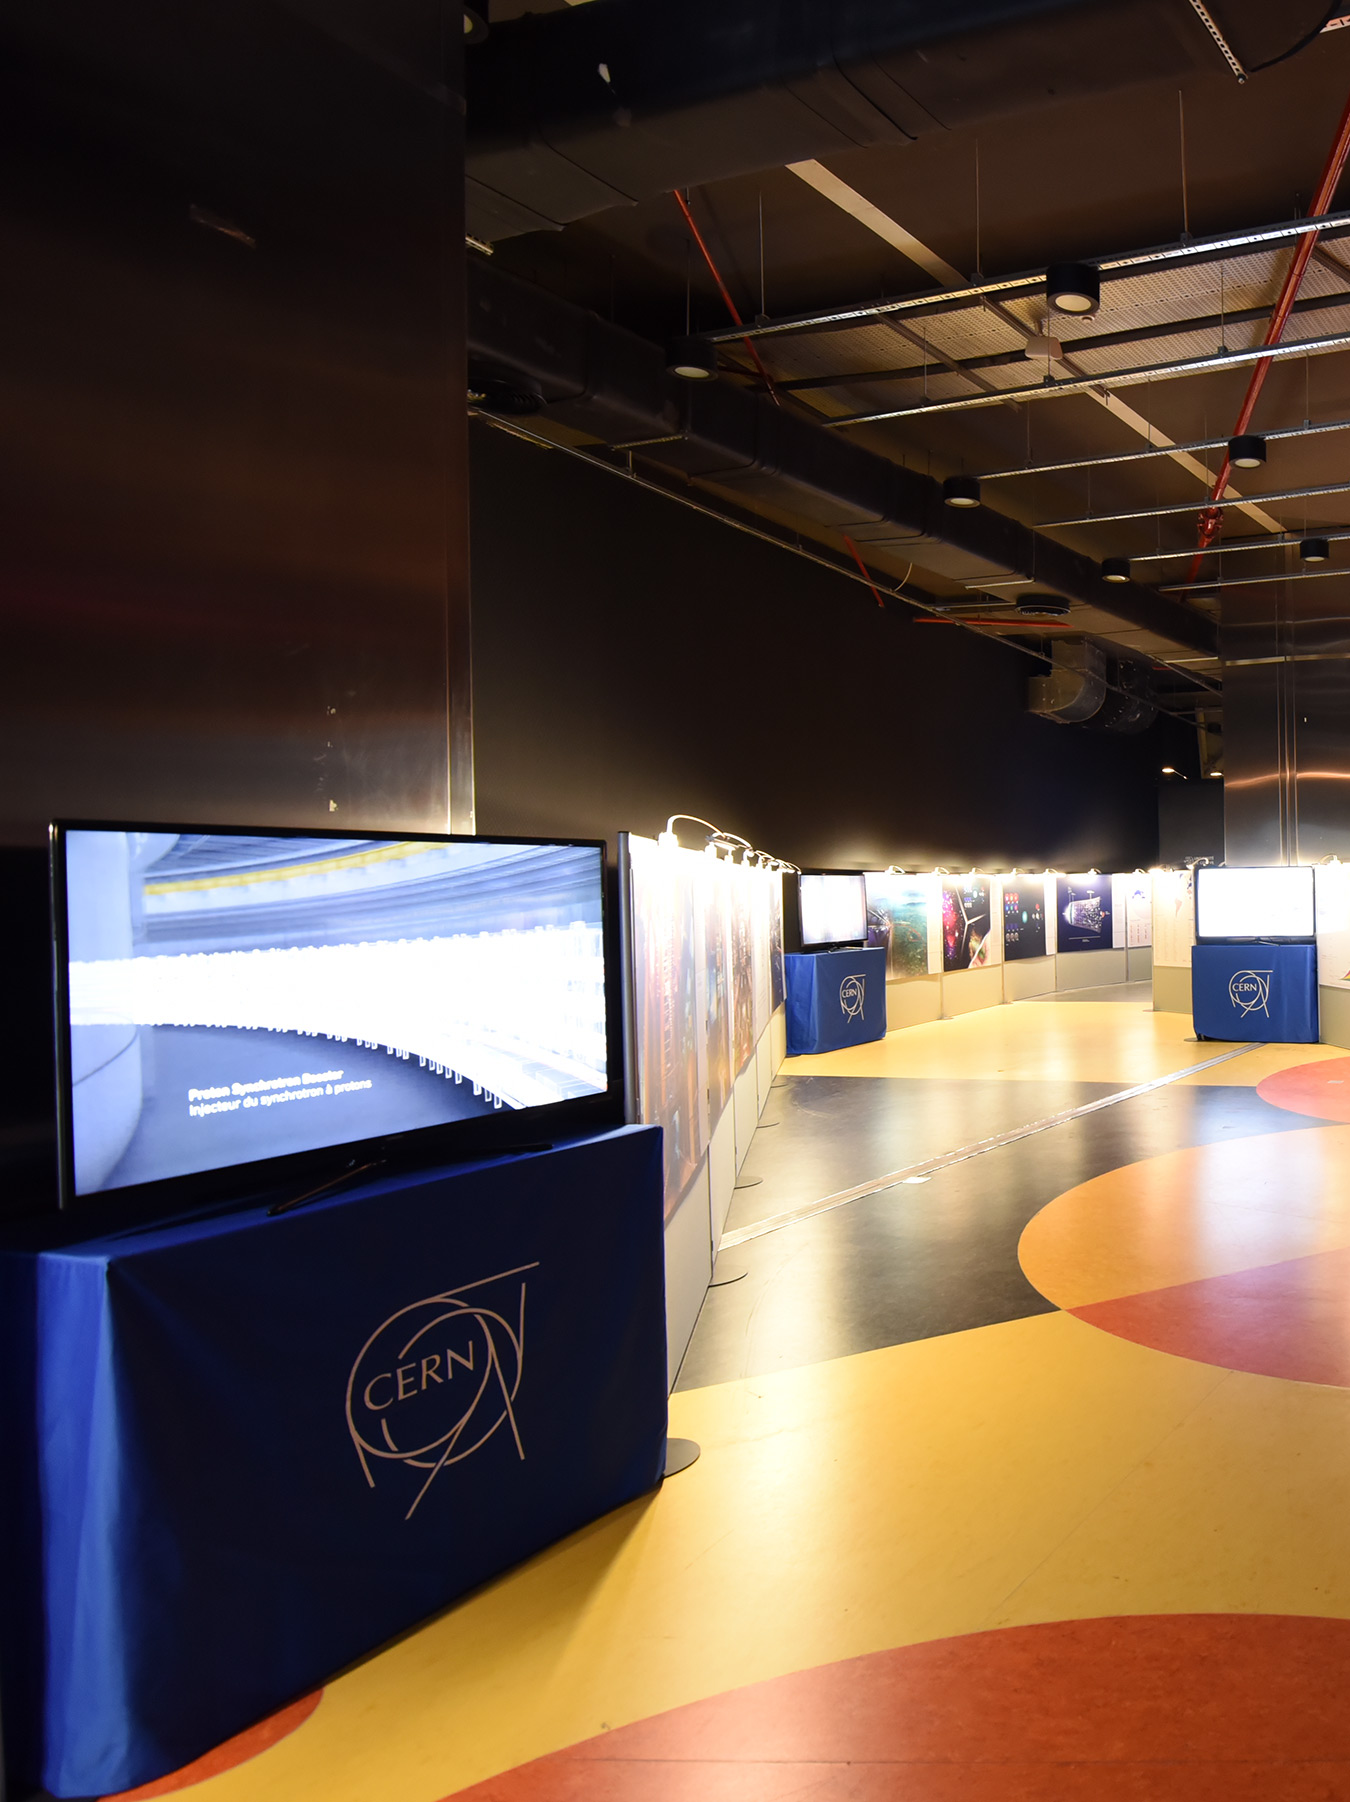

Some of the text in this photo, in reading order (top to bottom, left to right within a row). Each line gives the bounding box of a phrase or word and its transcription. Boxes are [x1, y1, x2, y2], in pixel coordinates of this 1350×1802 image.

[1232, 983, 1257, 992] CERN
[243, 1096, 258, 1108] du
[364, 1340, 474, 1411] CERN
